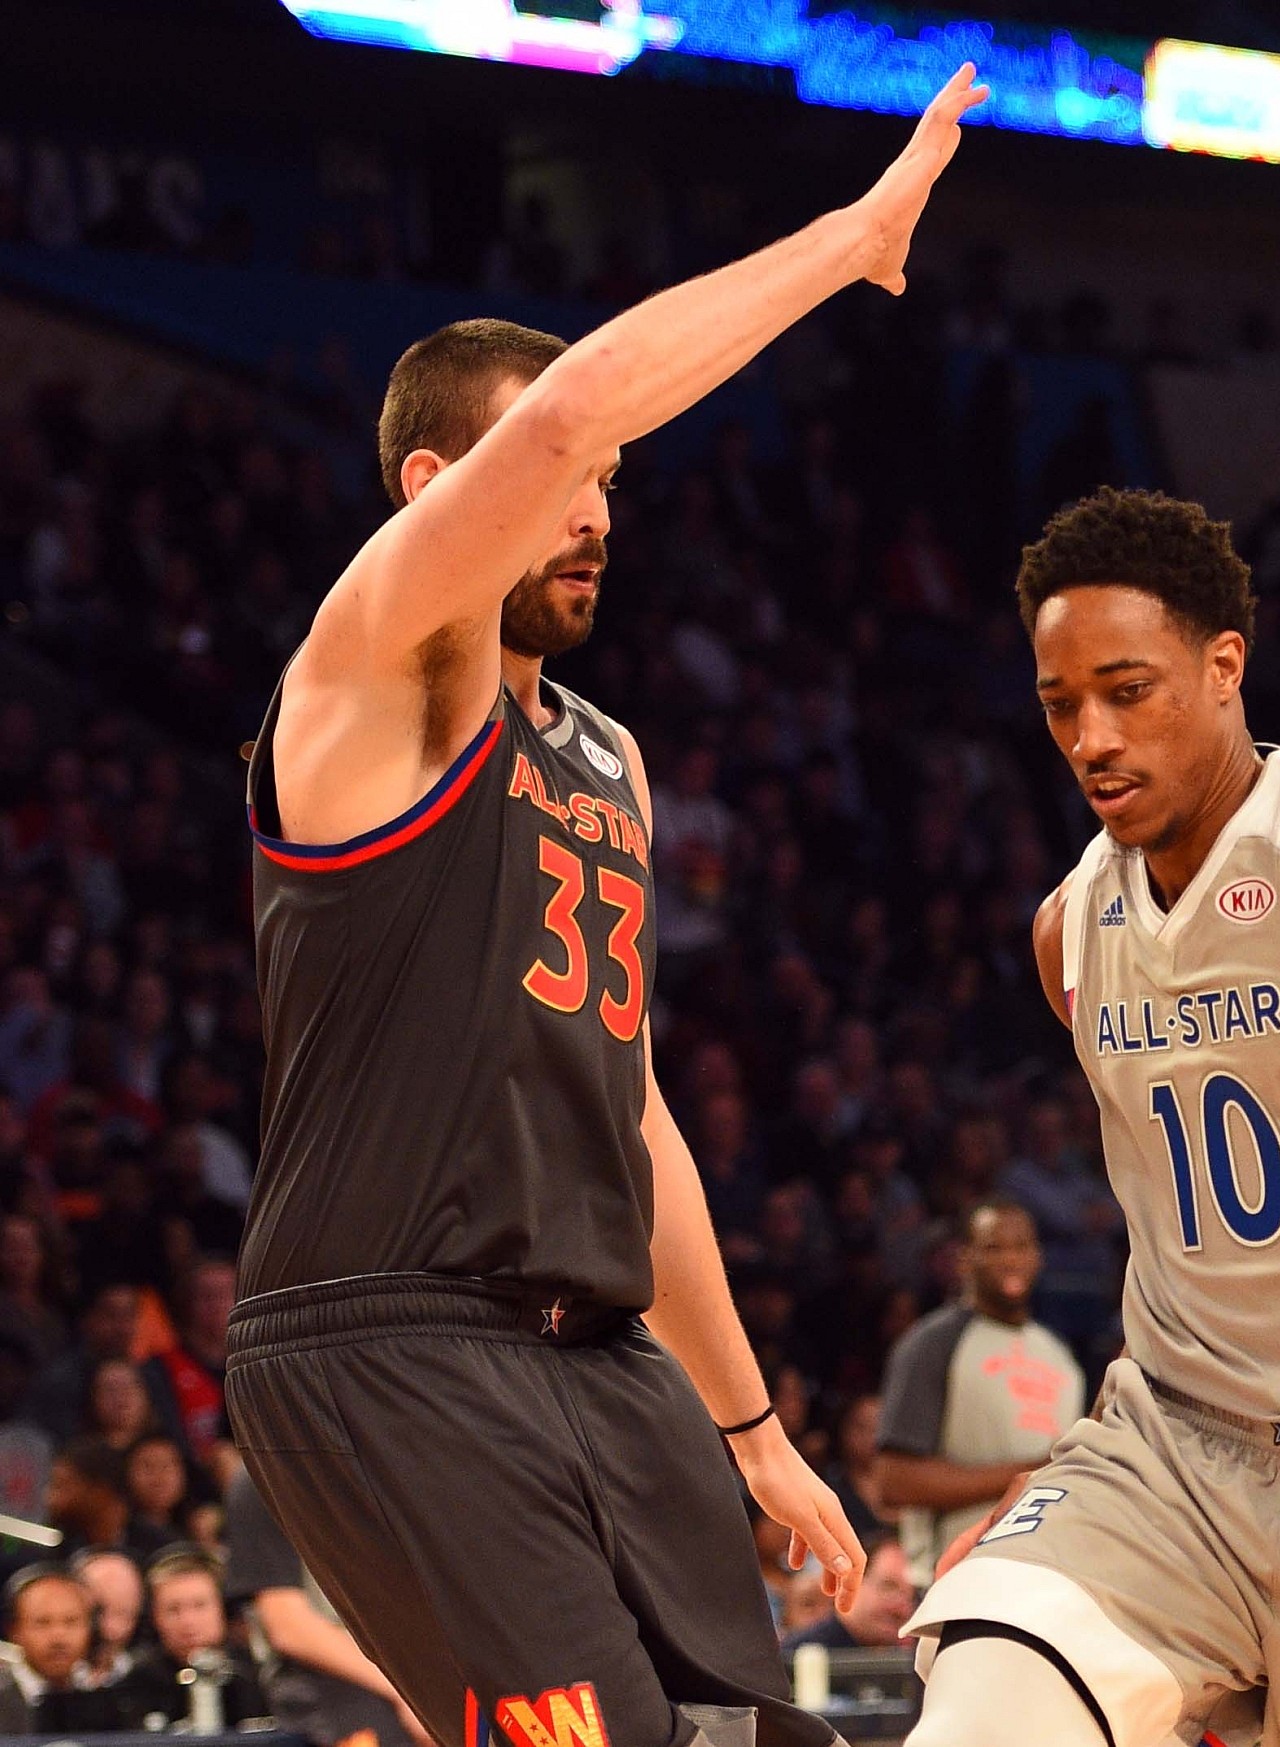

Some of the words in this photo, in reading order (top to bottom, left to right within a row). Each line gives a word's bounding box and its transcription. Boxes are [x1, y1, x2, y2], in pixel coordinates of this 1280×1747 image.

[1231, 889, 1265, 912] KIA
[522, 834, 645, 1042] 33
[977, 1487, 1069, 1547] E
